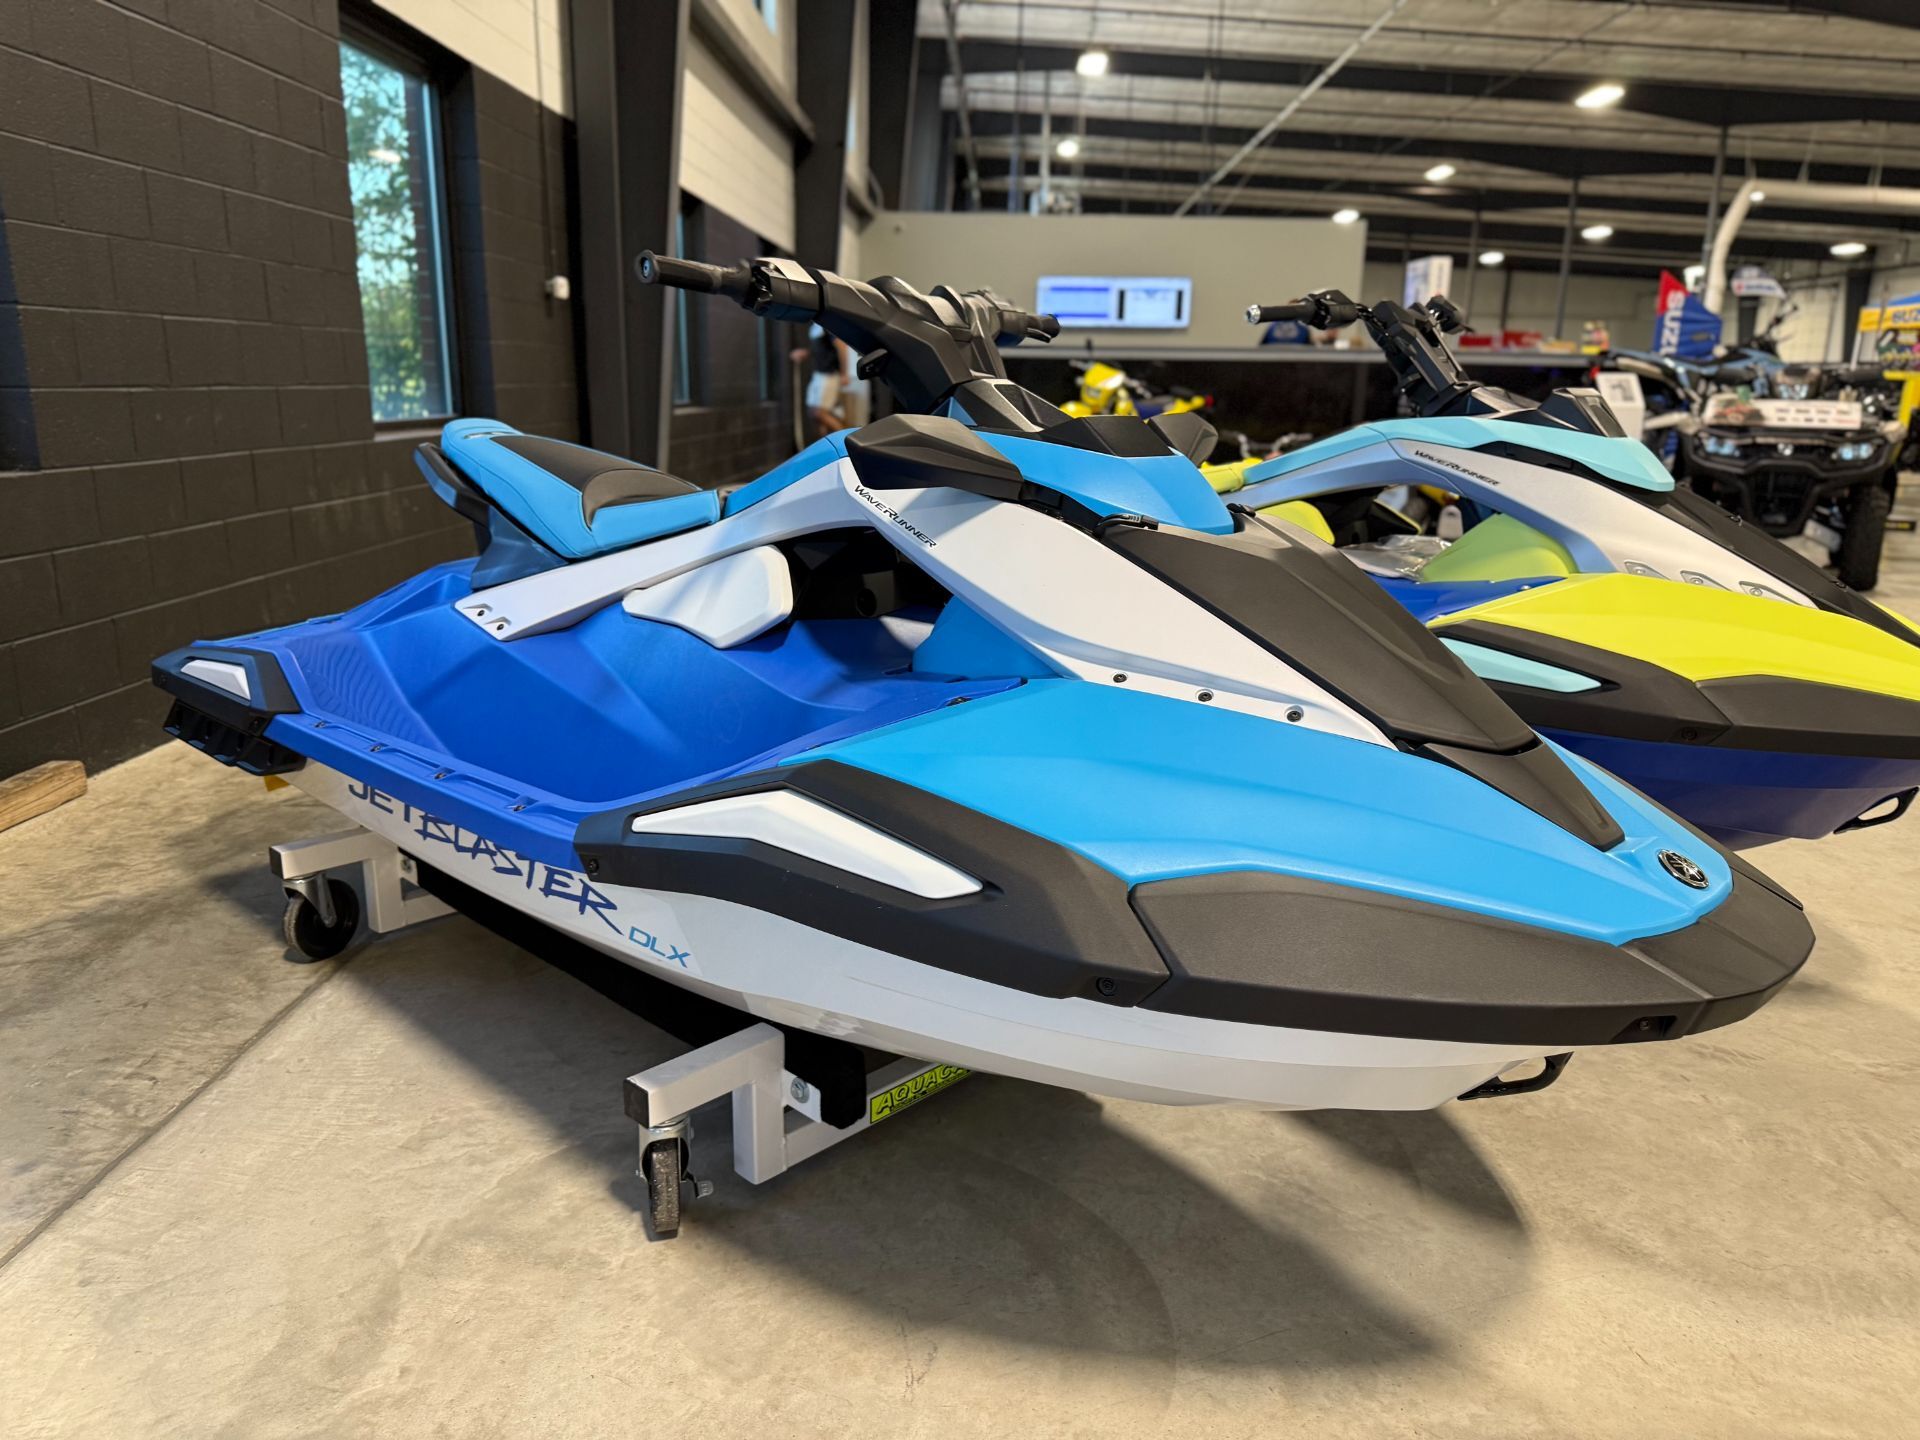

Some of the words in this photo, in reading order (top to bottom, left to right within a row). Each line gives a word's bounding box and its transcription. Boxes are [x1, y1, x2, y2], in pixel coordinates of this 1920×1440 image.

[1414, 450, 1499, 485] WAVERUNNER
[855, 485, 937, 547] WAVERUNNER
[628, 927, 691, 968] DLX
